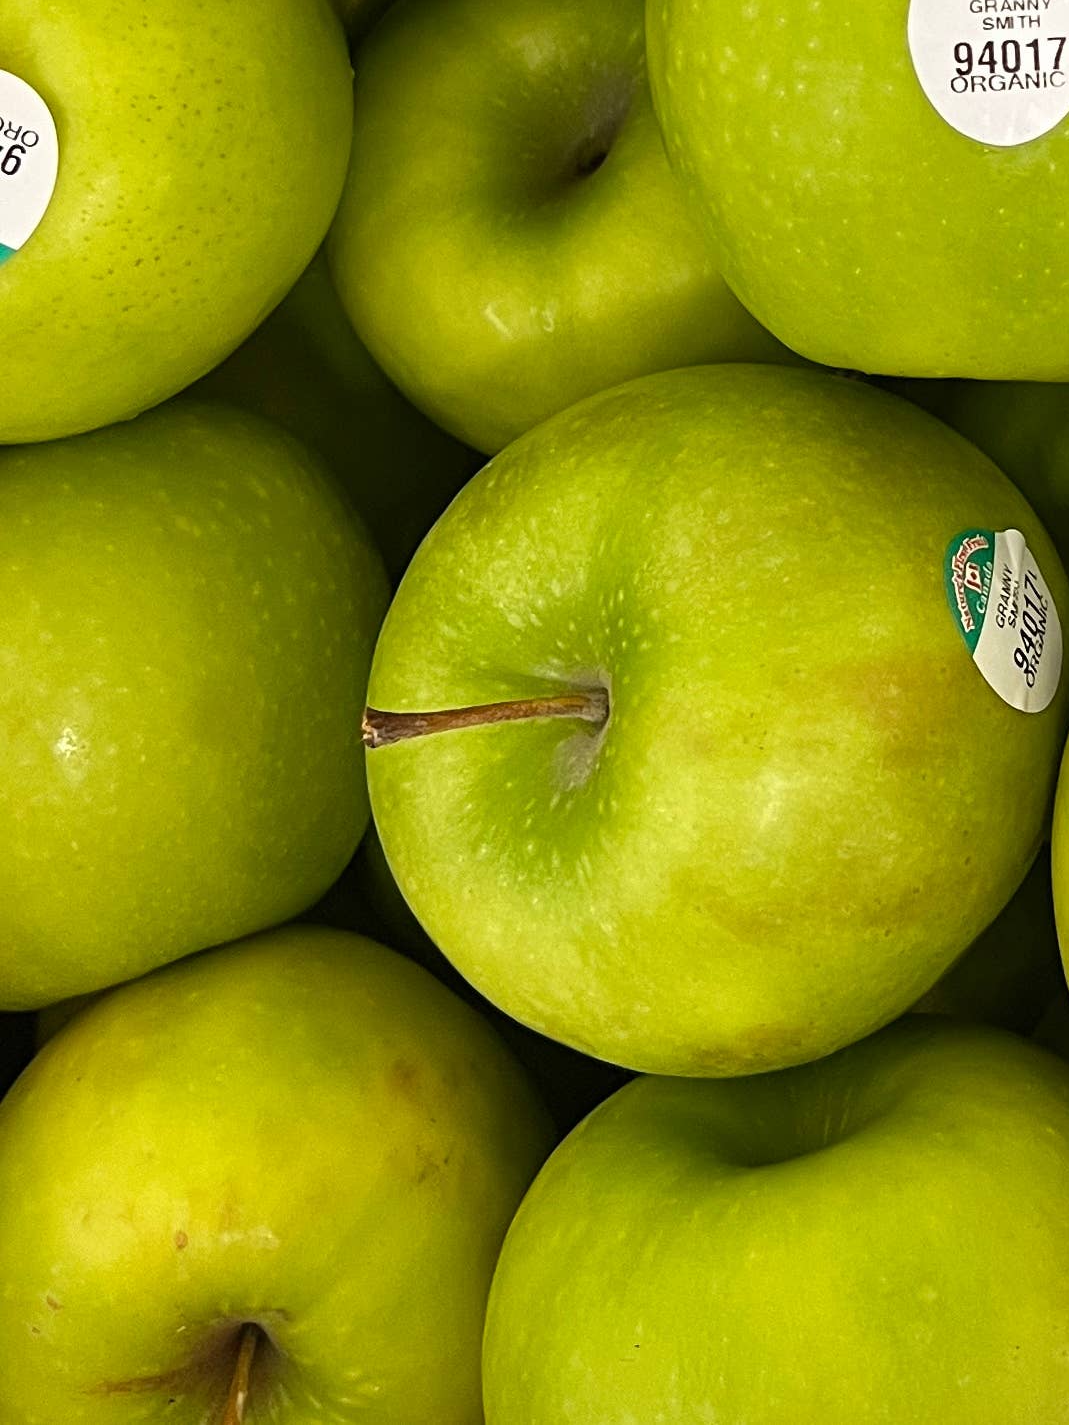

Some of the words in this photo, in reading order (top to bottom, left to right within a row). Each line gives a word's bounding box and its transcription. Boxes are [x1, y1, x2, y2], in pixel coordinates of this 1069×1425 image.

[982, 15, 1041, 30] SMITH
[950, 71, 1066, 93] ORGANIC
[995, 563, 1013, 629] GRANNY
[1025, 598, 1049, 688] ORGANIC
